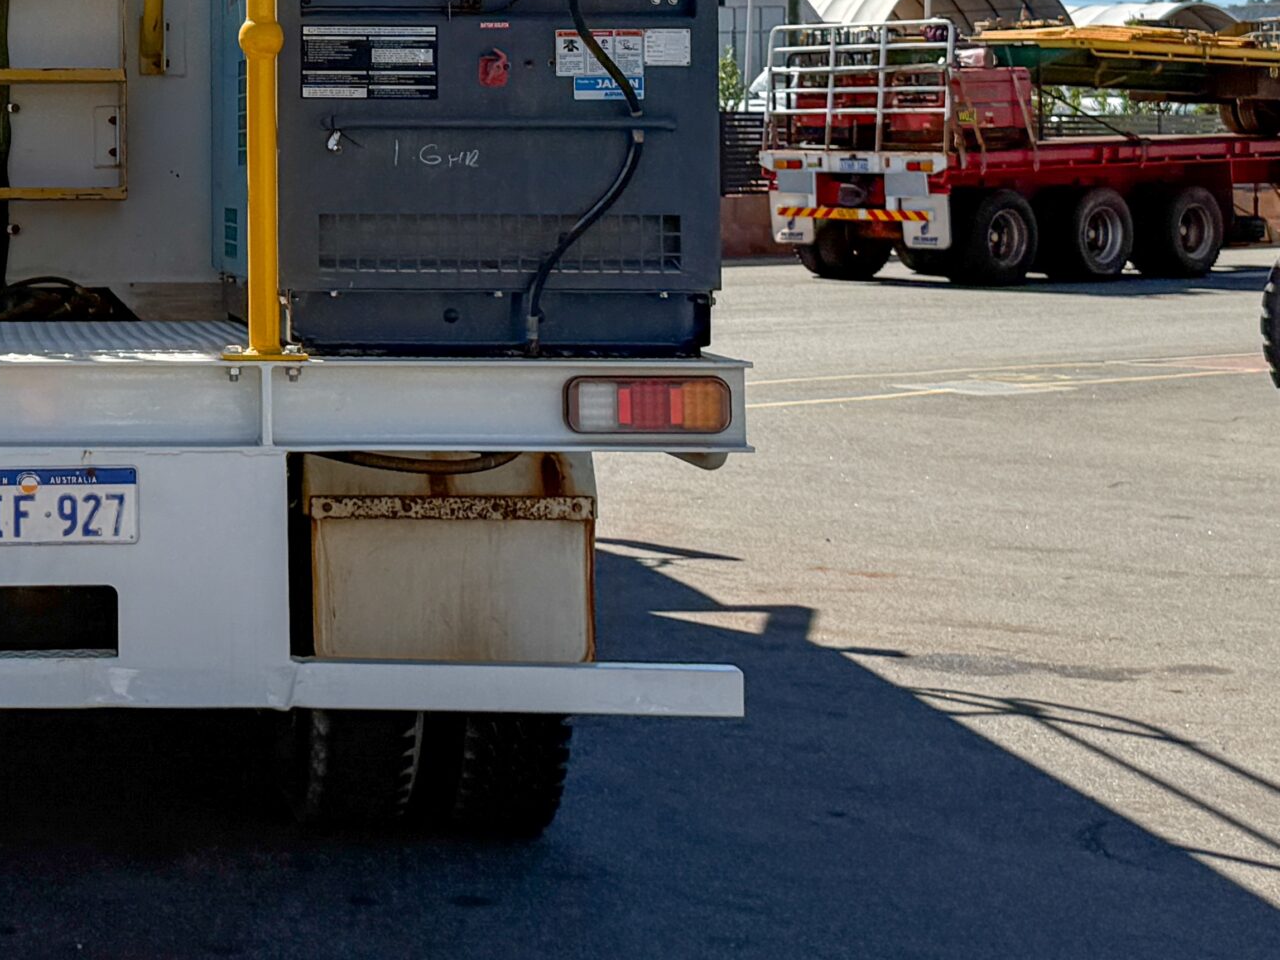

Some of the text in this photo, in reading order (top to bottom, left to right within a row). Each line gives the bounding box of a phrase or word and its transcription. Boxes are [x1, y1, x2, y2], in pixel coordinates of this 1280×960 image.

[595, 78, 639, 89] JAPN
[50, 475, 98, 485] AUSTRALIA
[57, 492, 125, 537] 927
